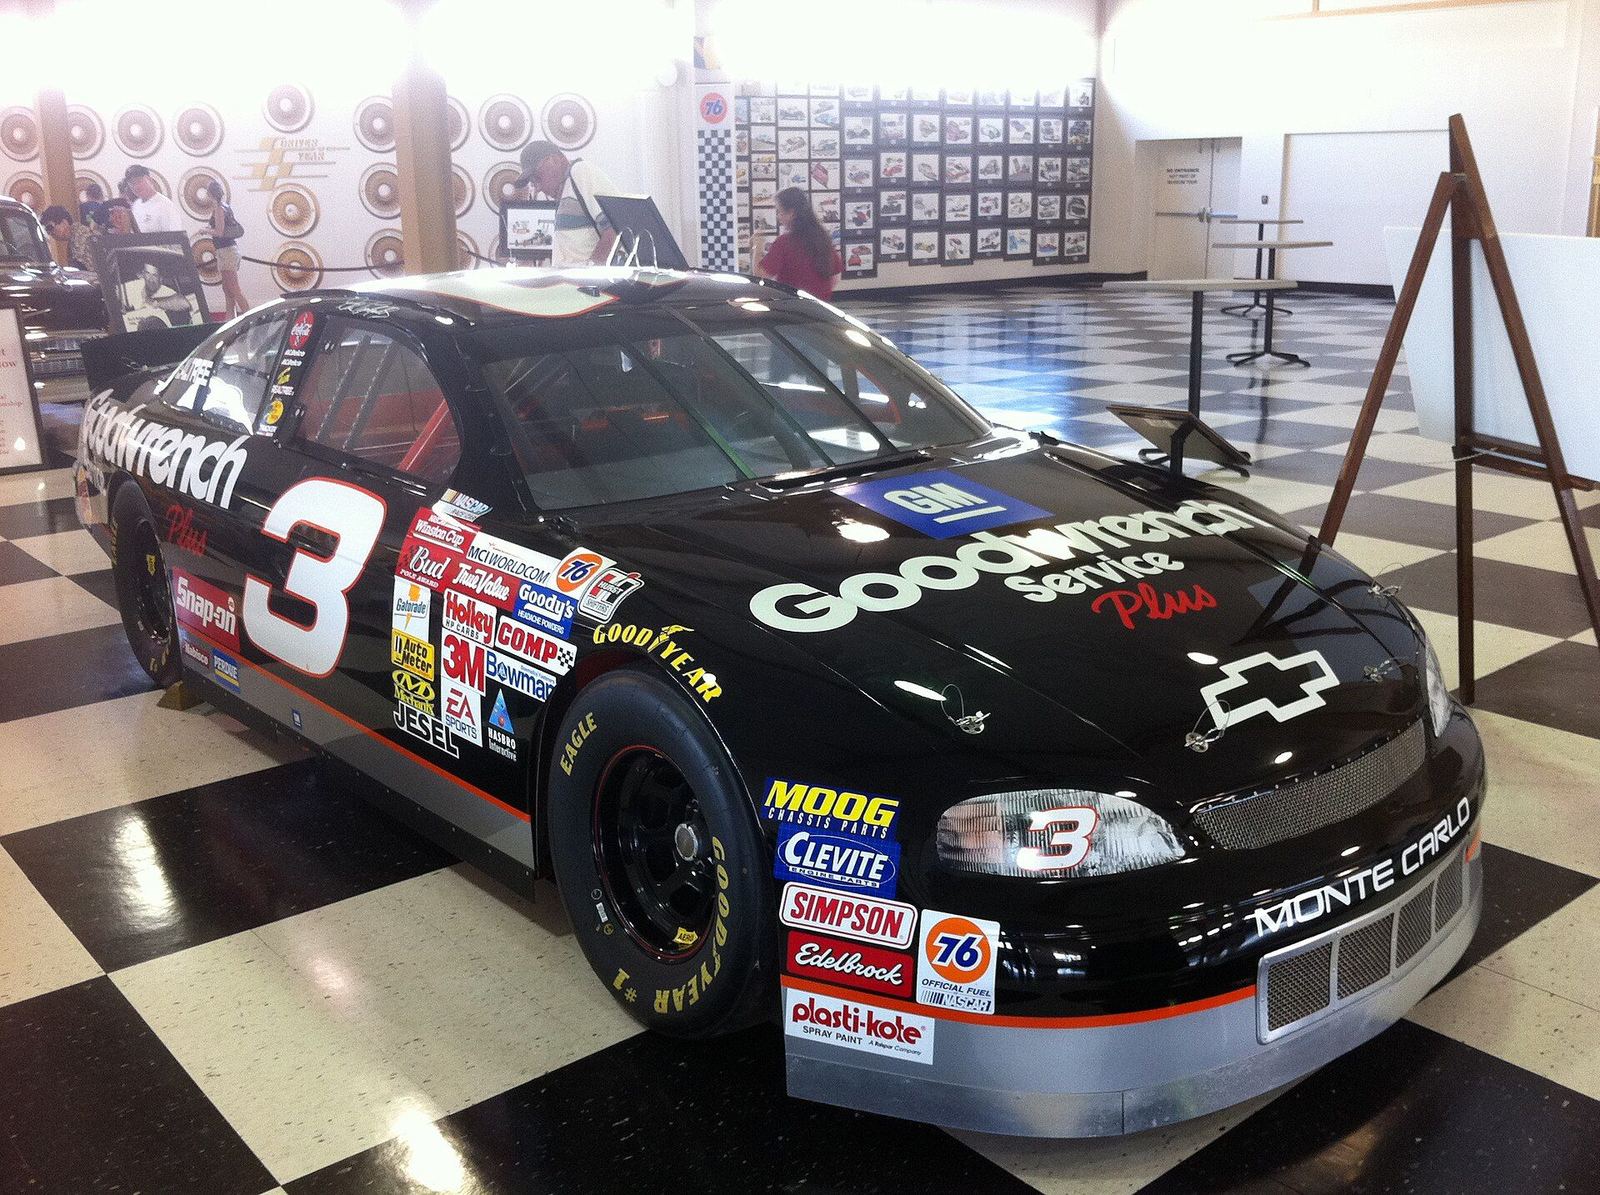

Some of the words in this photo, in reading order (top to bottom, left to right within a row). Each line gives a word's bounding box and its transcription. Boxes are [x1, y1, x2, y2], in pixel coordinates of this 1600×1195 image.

[705, 99, 724, 116] 76
[453, 492, 490, 515] NASCAR
[884, 483, 988, 516] GM
[165, 504, 208, 556] Plus
[415, 518, 447, 541] Winston
[444, 529, 465, 548] Cup
[243, 476, 388, 679] 3
[400, 569, 417, 580] POLE
[416, 574, 440, 589] AWARD
[409, 545, 452, 580] Bud
[560, 559, 598, 583] 76
[749, 498, 1276, 634] Goodwrench
[519, 583, 575, 620] Goody's
[598, 580, 622, 595] HURST
[175, 576, 237, 636] Snap-on
[396, 598, 427, 615] Gatorade
[446, 591, 494, 644] Holley
[517, 609, 543, 627] HEADACHE
[541, 617, 565, 635] POWDERS
[1091, 581, 1217, 630] Plus
[405, 639, 428, 657] Auto
[457, 625, 480, 640] CARBS
[497, 622, 559, 664] COMP
[213, 655, 239, 680] PERDUE
[401, 649, 433, 673] Meter
[442, 633, 486, 693] 3M
[593, 623, 723, 703] GOODYEAR
[445, 687, 476, 726] EA
[393, 700, 460, 760] JESEL
[444, 713, 478, 740] SPORTS
[487, 726, 517, 751] HASBRO
[488, 739, 518, 762] Interactive
[559, 712, 599, 777] EAGLE
[764, 780, 900, 828] MOOG
[767, 807, 831, 830] CHASSIS
[840, 816, 889, 840] PARTS
[1016, 805, 1100, 872] 3
[784, 831, 889, 881] CLEVITE
[1254, 858, 1396, 937] MONTE
[1400, 796, 1471, 874] CARLO
[791, 867, 835, 880] ENGINE
[840, 876, 878, 888] PARTS
[790, 890, 905, 940] SIMPSON
[794, 942, 903, 986] Edelbrock
[932, 933, 982, 971] 76
[921, 978, 964, 994] OFFICIAL
[966, 987, 992, 998] FUEL
[943, 992, 992, 1013] NASCAR
[792, 997, 922, 1045] plasti-kote
[802, 1025, 832, 1039] SPRAY
[835, 1032, 863, 1046] PAINT
[893, 1044, 923, 1057] Company
